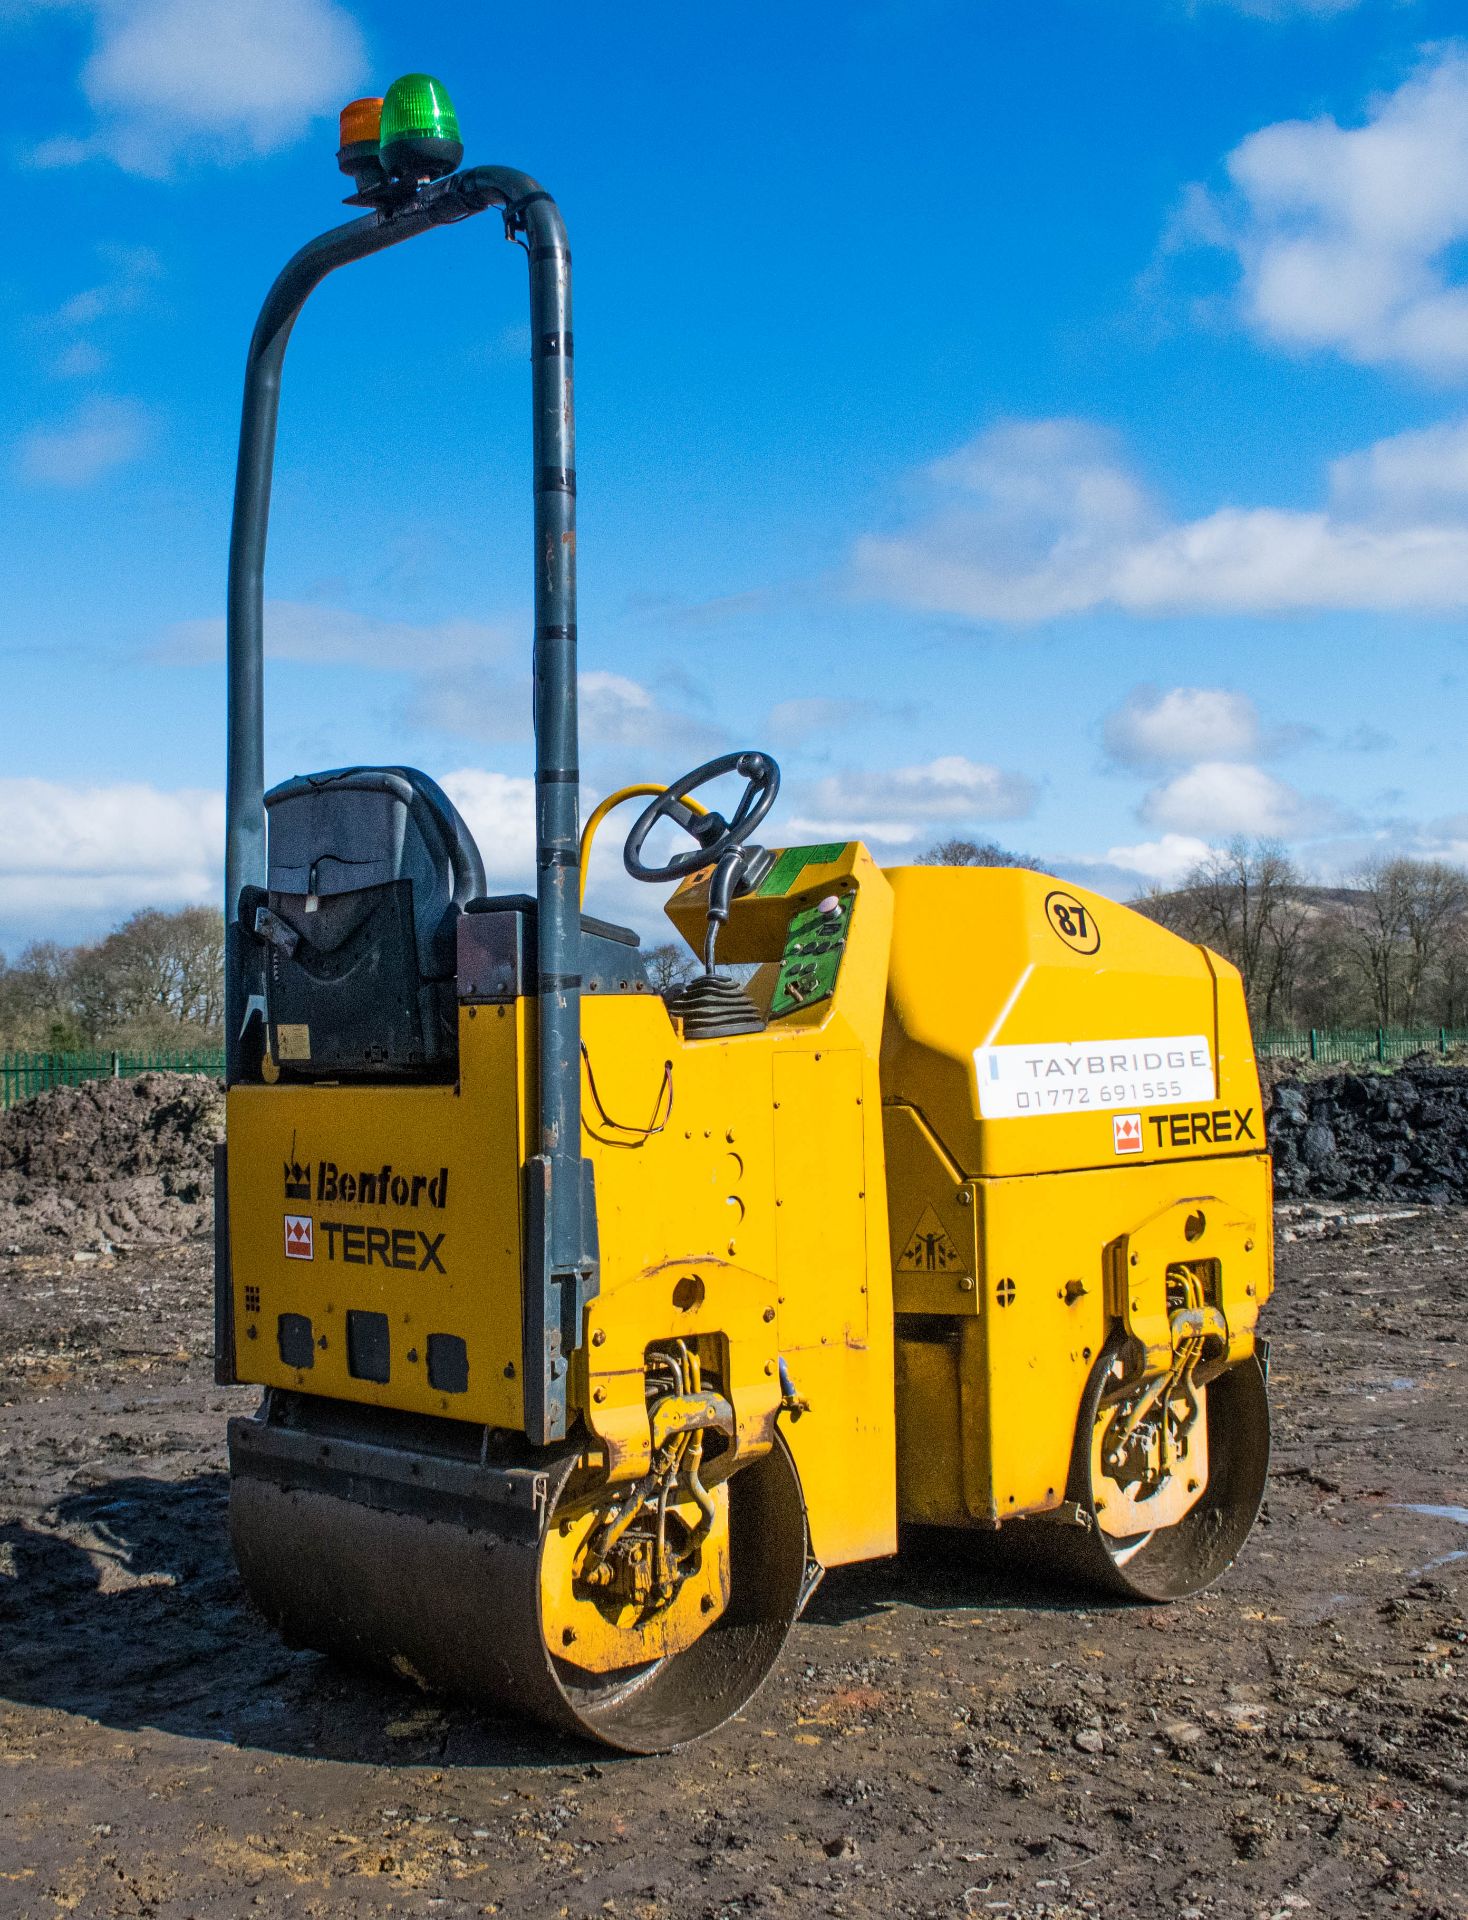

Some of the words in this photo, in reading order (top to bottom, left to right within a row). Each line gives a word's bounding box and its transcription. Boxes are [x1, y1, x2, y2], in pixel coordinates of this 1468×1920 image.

[1053, 903, 1088, 938] 87
[1025, 1050, 1208, 1078] TAYBRIDGE
[1016, 1087, 1090, 1108] 01772
[1100, 1080, 1182, 1101] 691555
[1149, 1108, 1256, 1148] TEREX
[317, 1161, 449, 1209] Benford
[320, 1221, 447, 1274] TEREX
